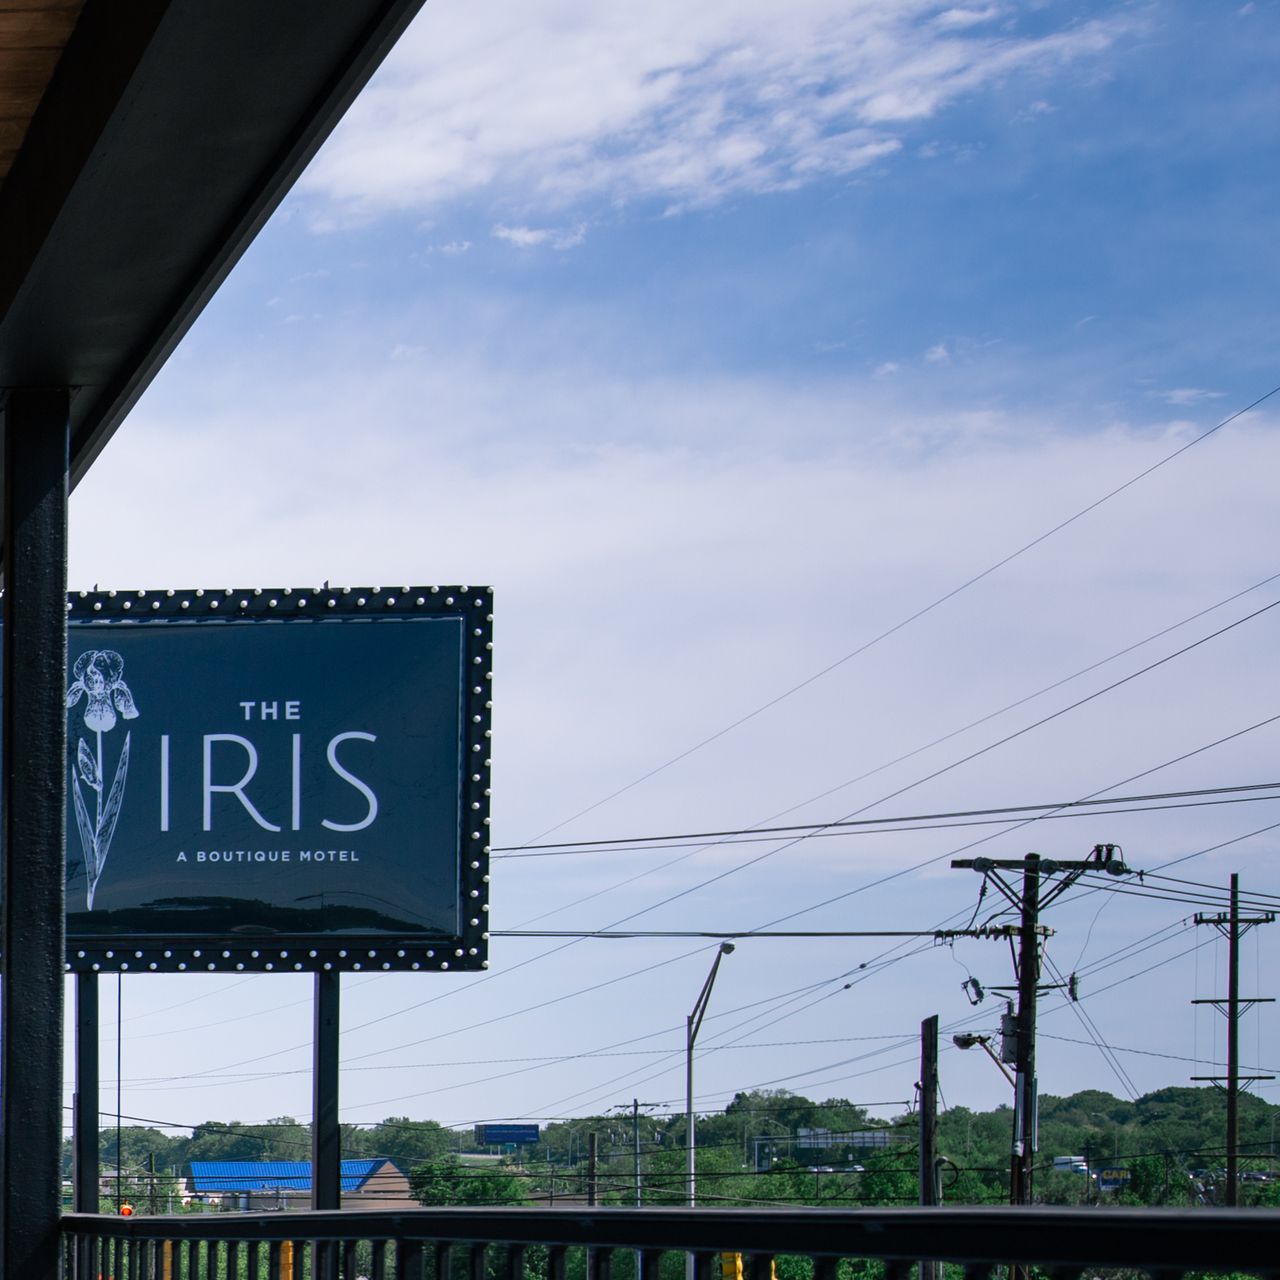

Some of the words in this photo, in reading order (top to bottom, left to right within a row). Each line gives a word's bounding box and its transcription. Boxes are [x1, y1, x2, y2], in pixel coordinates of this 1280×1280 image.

[240, 701, 301, 720] THE
[160, 731, 378, 832] IRIS
[176, 852, 188, 862] A
[196, 851, 290, 862] BOUTIQUE
[300, 851, 360, 862] MOTEL
